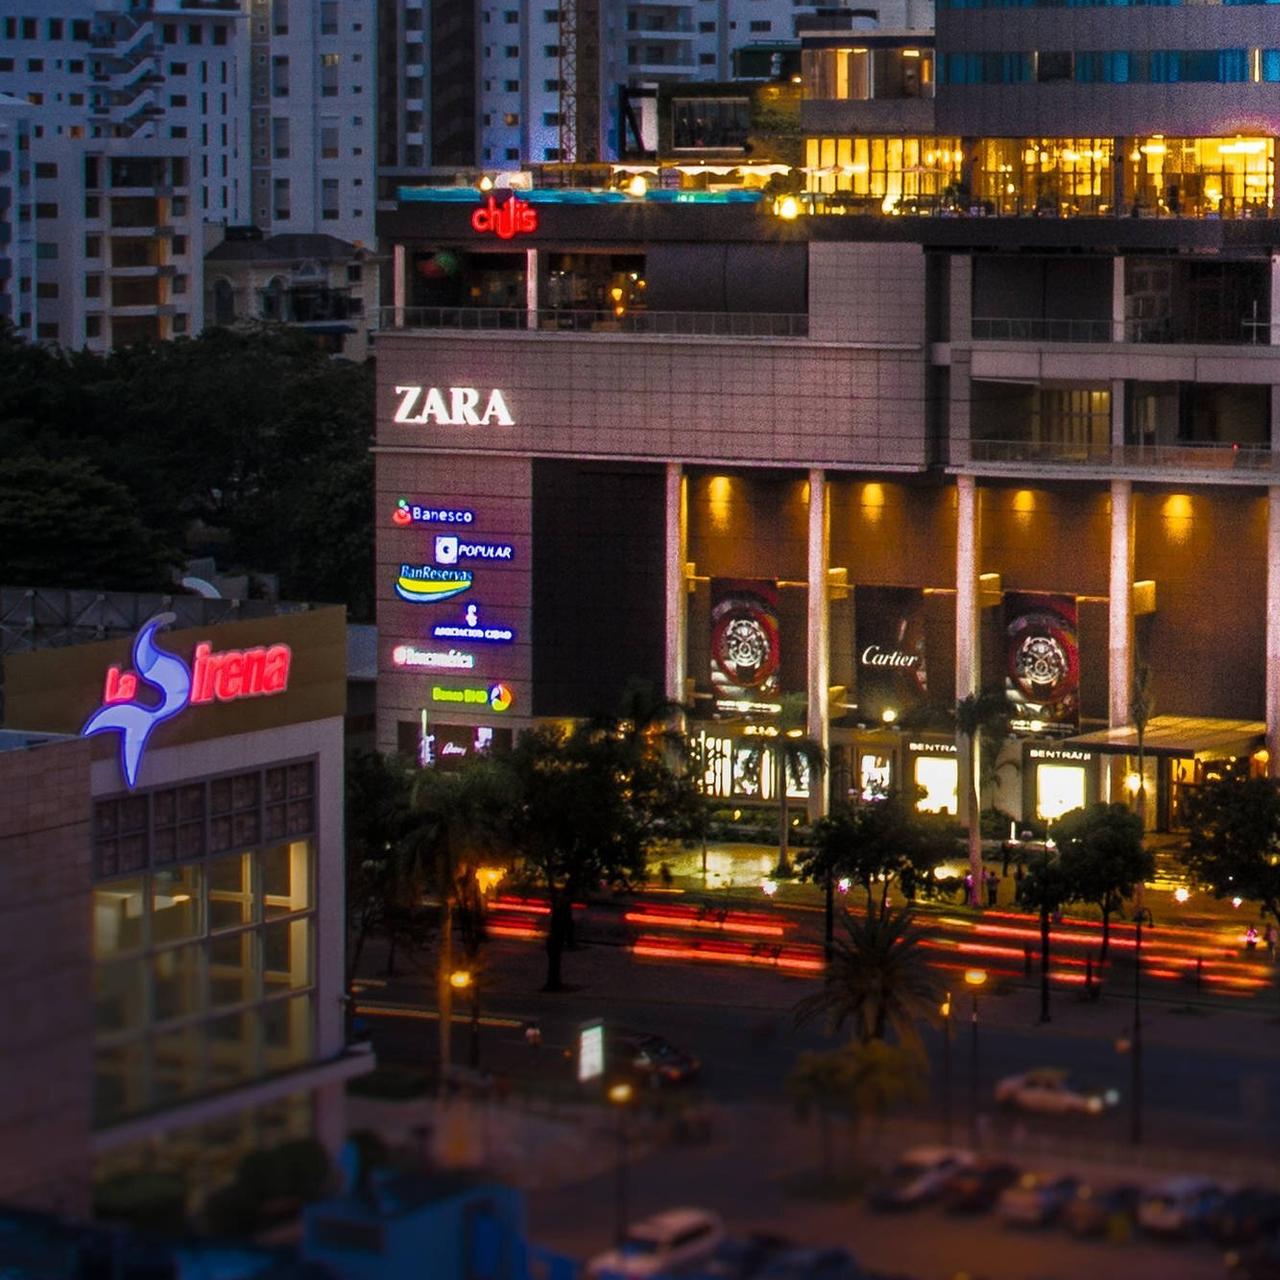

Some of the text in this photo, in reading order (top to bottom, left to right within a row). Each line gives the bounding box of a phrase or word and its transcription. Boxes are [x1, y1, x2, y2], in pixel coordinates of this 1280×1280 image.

[394, 385, 516, 426] ZARA
[412, 506, 473, 523] Banesco
[458, 544, 512, 559] POPULAR
[401, 564, 473, 582] BanReservas
[861, 644, 919, 667] Cartier
